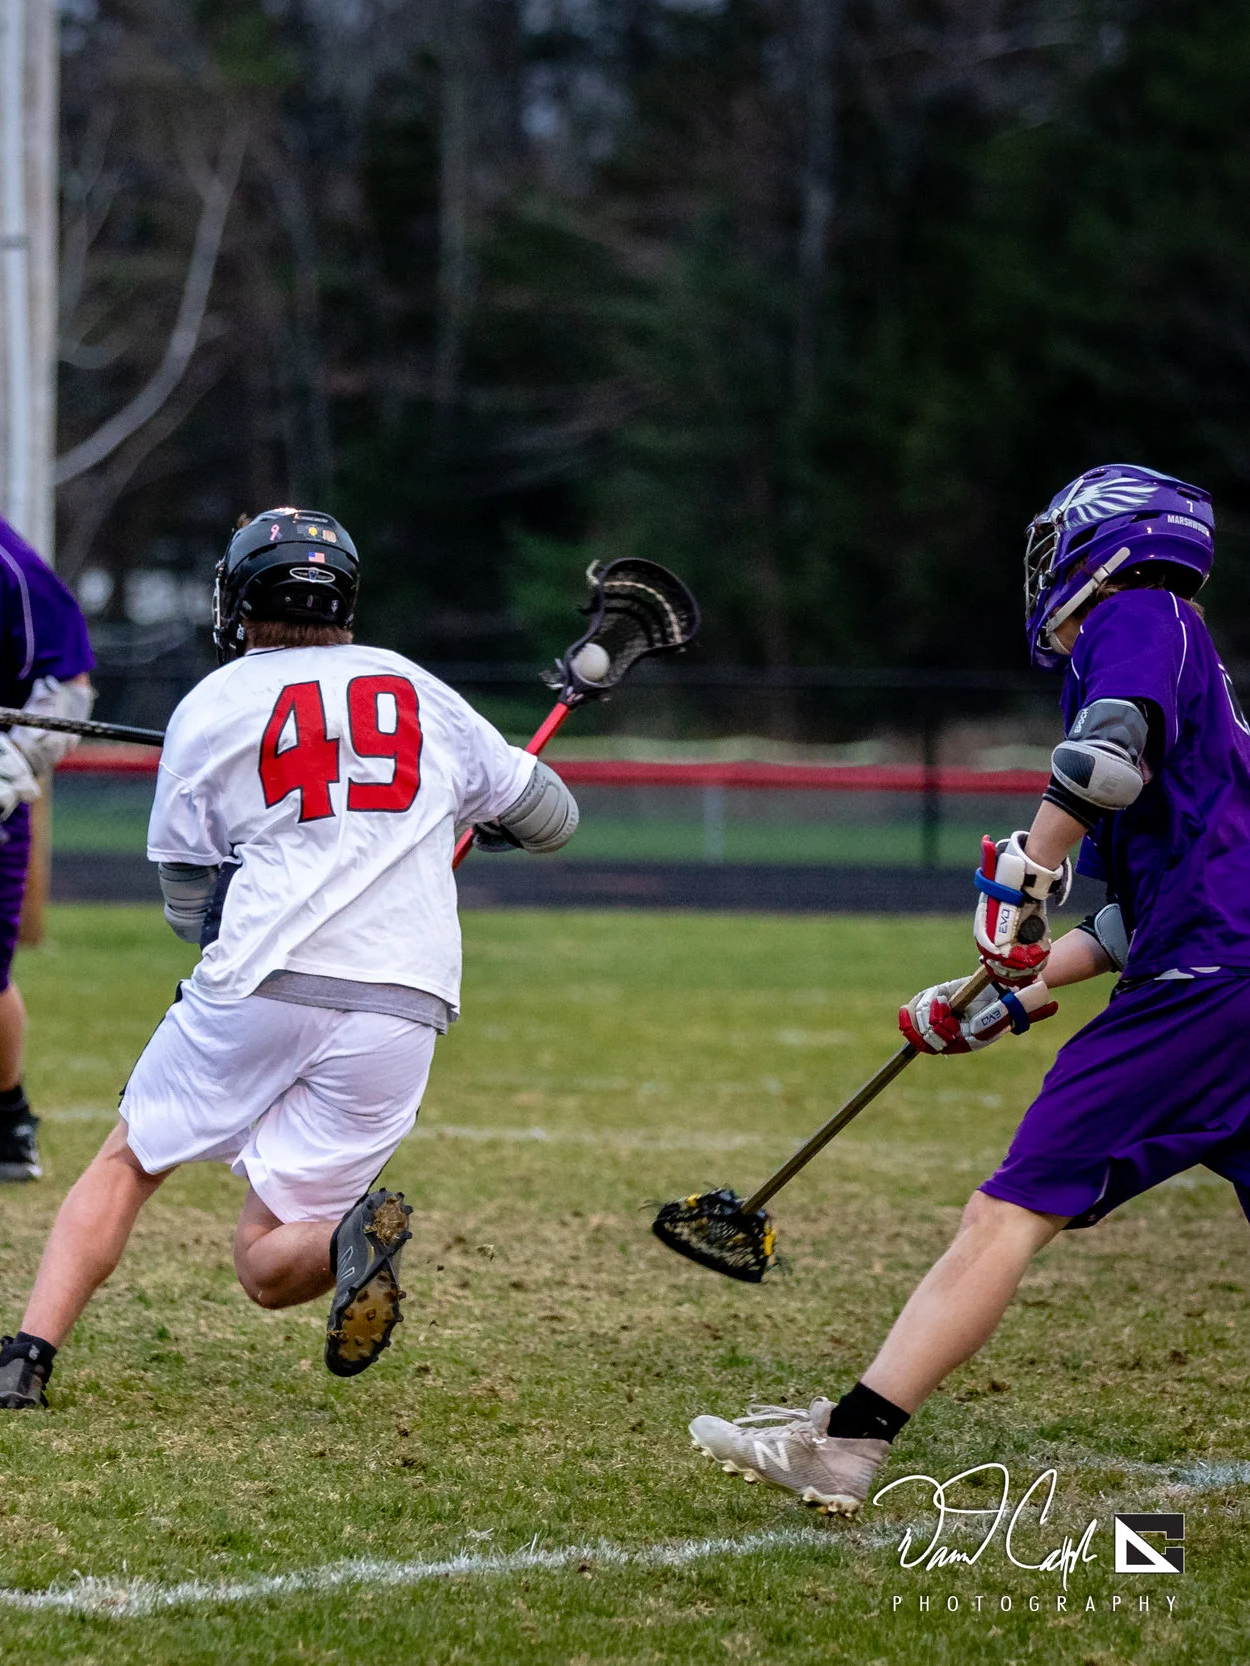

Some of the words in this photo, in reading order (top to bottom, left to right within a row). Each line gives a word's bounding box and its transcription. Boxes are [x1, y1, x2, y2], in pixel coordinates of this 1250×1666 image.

[1186, 500, 1194, 513] 7
[1167, 514, 1210, 538] MARSH
[258, 674, 423, 824] 49
[999, 908, 1010, 934] EVO
